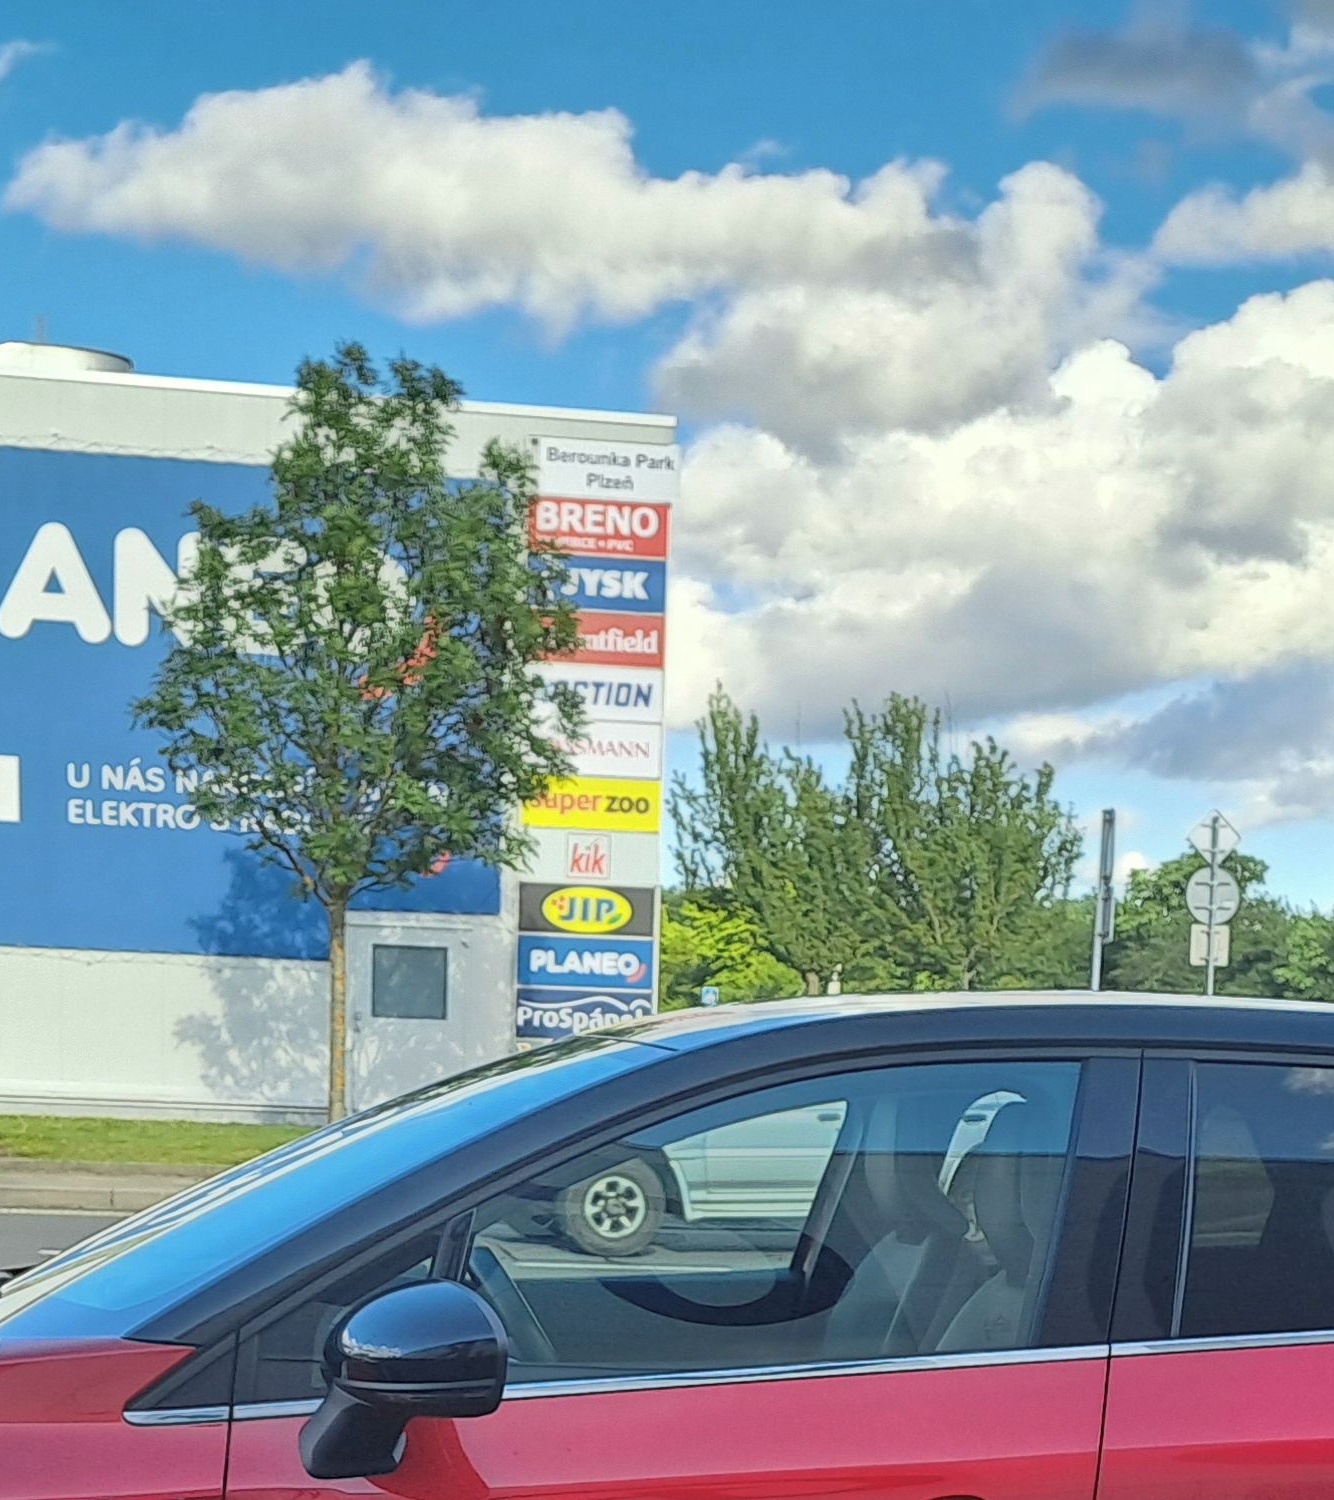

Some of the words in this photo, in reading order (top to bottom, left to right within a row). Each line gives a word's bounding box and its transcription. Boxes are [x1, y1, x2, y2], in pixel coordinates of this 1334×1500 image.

[546, 447, 632, 469] Berounka
[635, 453, 675, 472] Park
[586, 471, 635, 491] Plzeň
[534, 499, 660, 538] BRENO
[560, 567, 650, 600] JYSK
[576, 628, 659, 655] ntfield
[67, 762, 90, 789] U
[101, 757, 165, 793] NÁS
[67, 798, 201, 831] ELEKTRO
[559, 896, 616, 923] JIP
[528, 948, 640, 977] PLANEO
